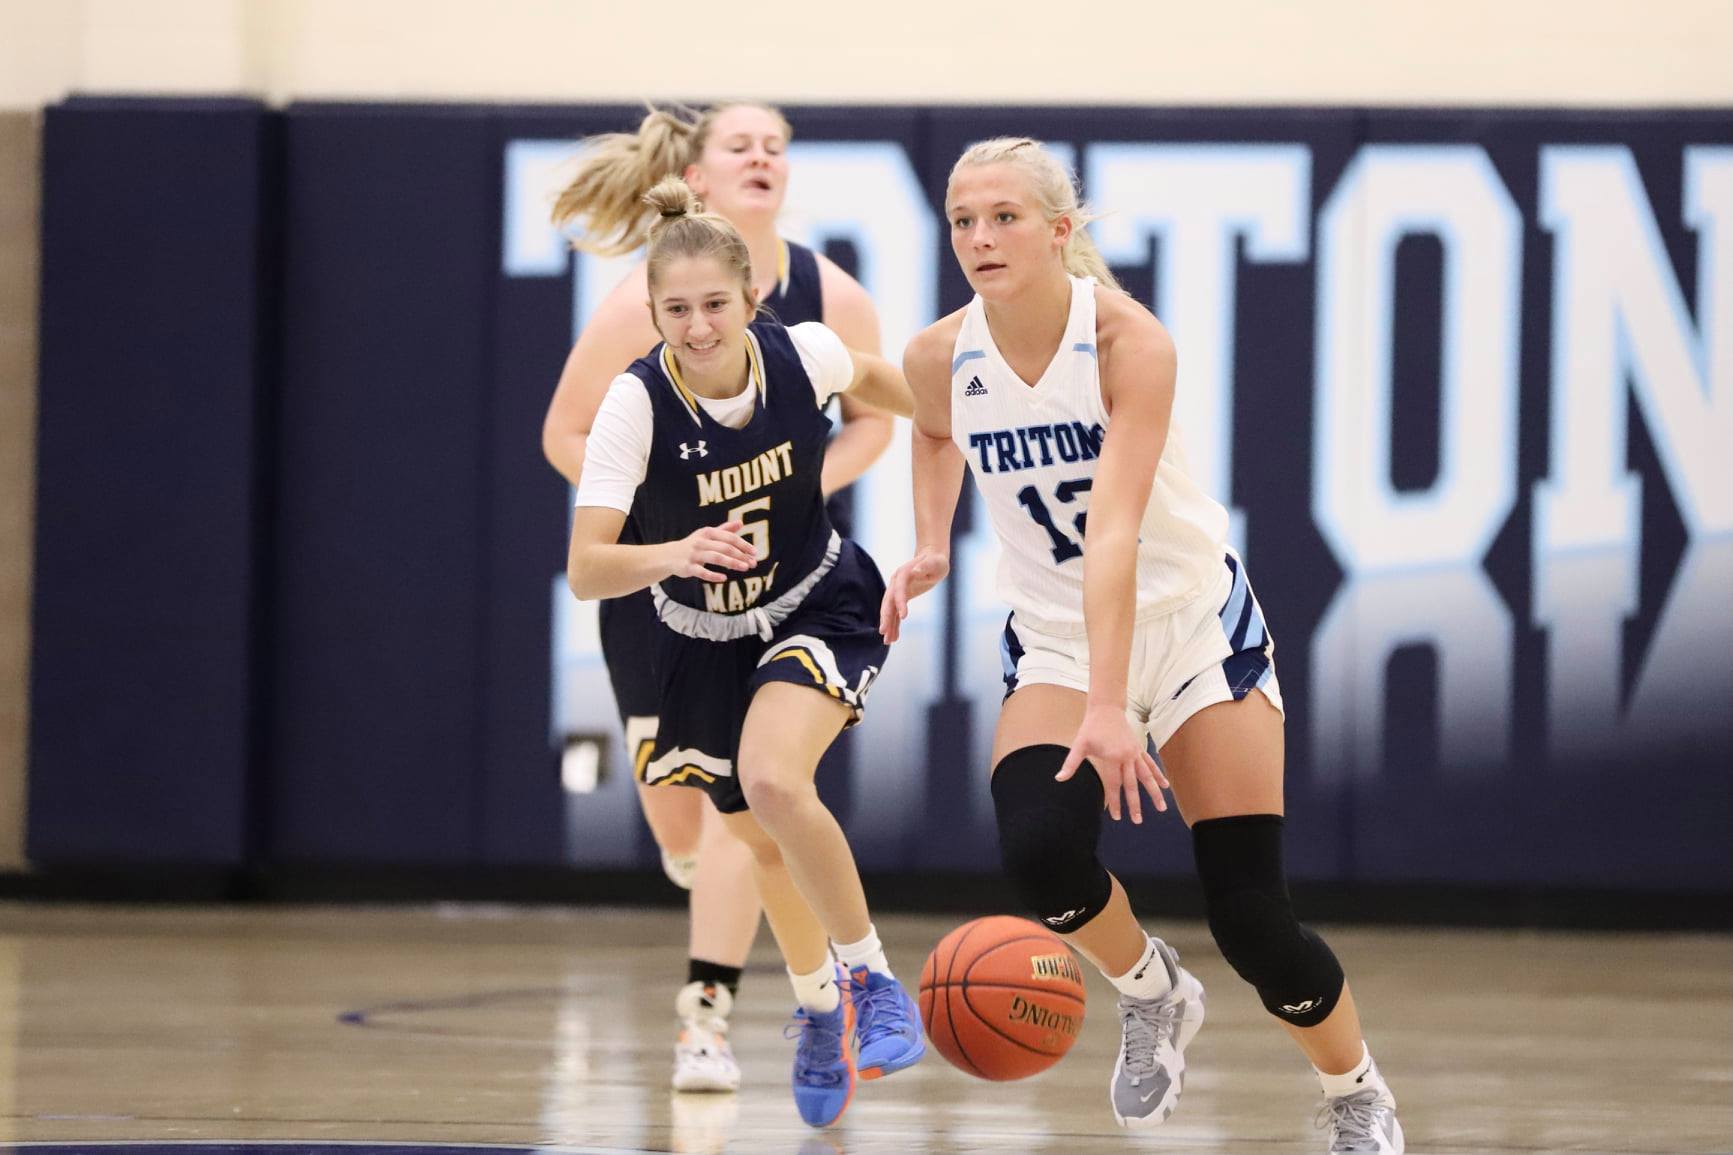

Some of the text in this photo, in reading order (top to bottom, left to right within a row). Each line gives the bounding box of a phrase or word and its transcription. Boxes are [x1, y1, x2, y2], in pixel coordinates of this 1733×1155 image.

[502, 140, 1733, 655] RTON
[964, 387, 989, 397] adidas
[695, 440, 793, 507] MOUNT
[1008, 995, 1081, 1037] ALDING
